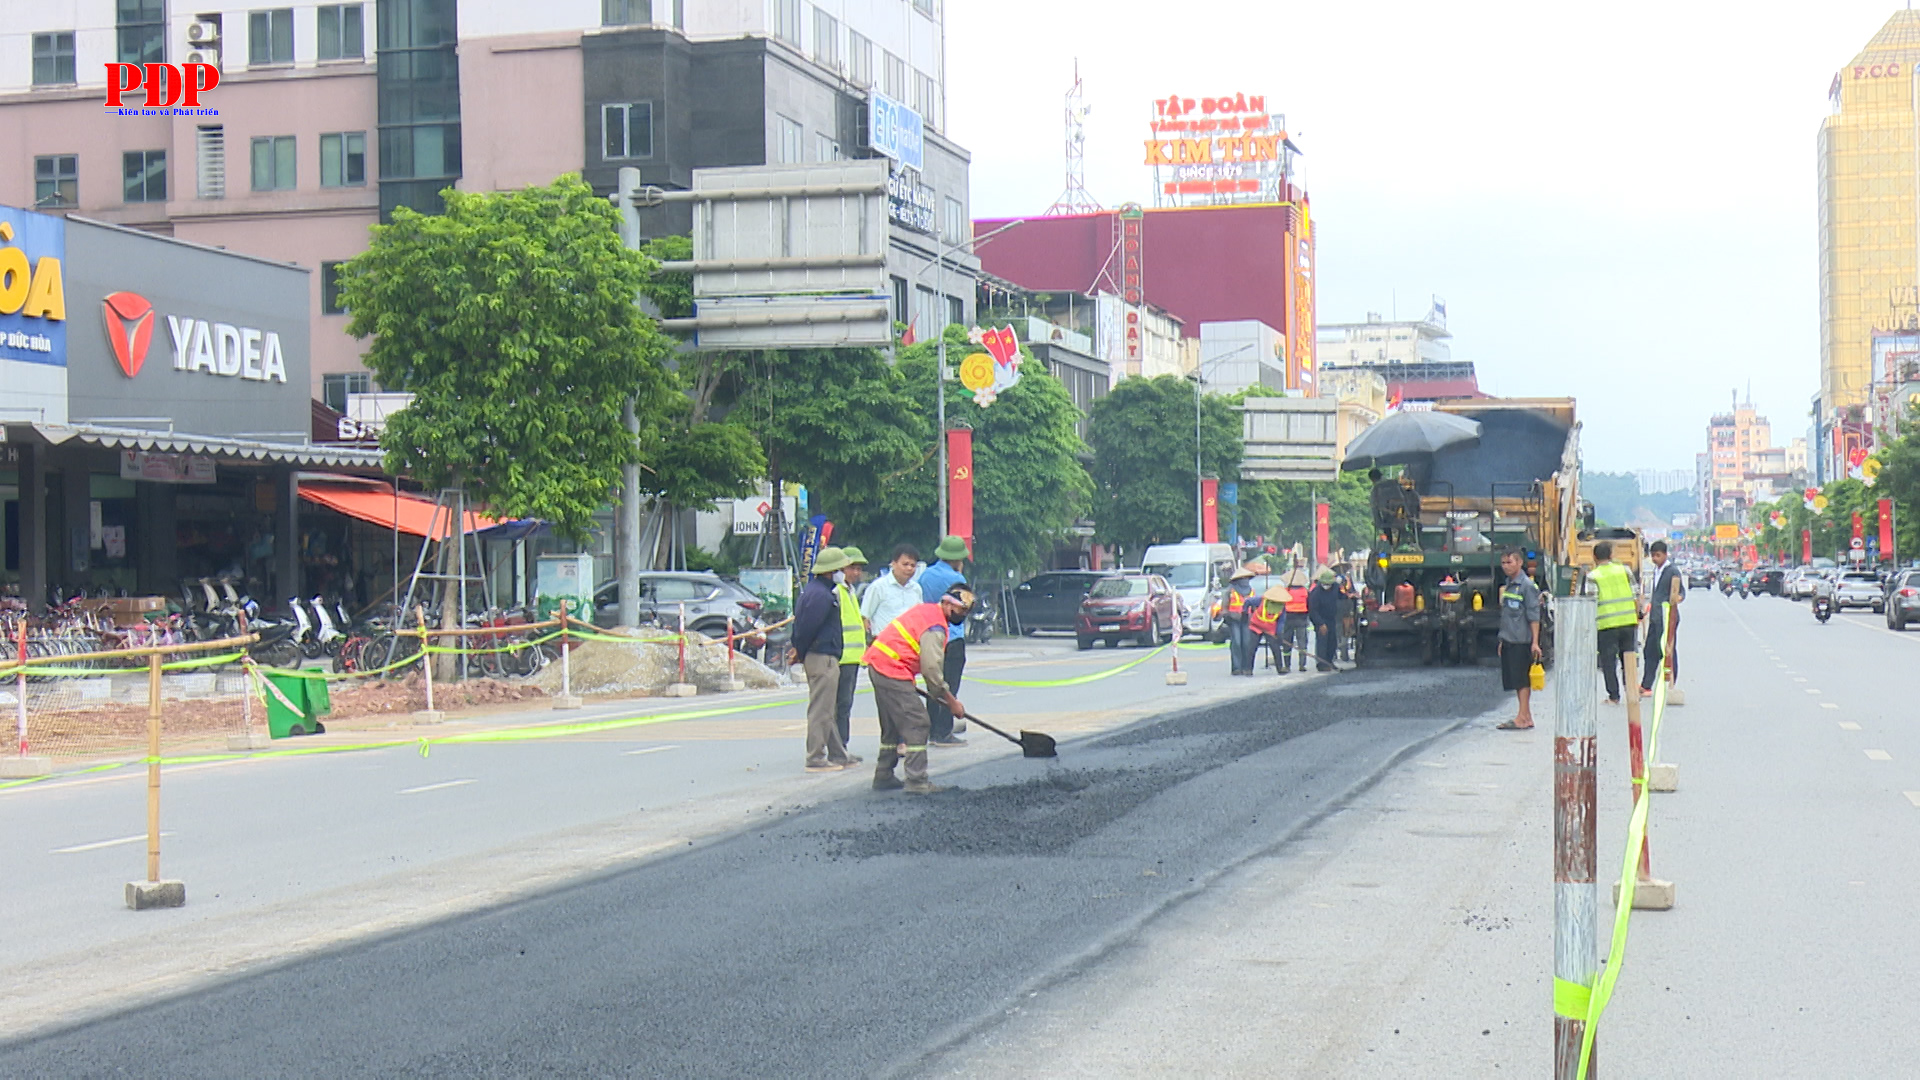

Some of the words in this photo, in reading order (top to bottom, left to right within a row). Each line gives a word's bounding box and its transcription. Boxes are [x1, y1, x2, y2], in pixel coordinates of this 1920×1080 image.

[1156, 94, 1196, 119] TẬP
[1201, 92, 1264, 114] ĐOÀN
[1144, 139, 1212, 165] KIM
[1218, 130, 1277, 163] TÍN
[167, 314, 287, 383] YADEA
[735, 521, 759, 532] JOHN
